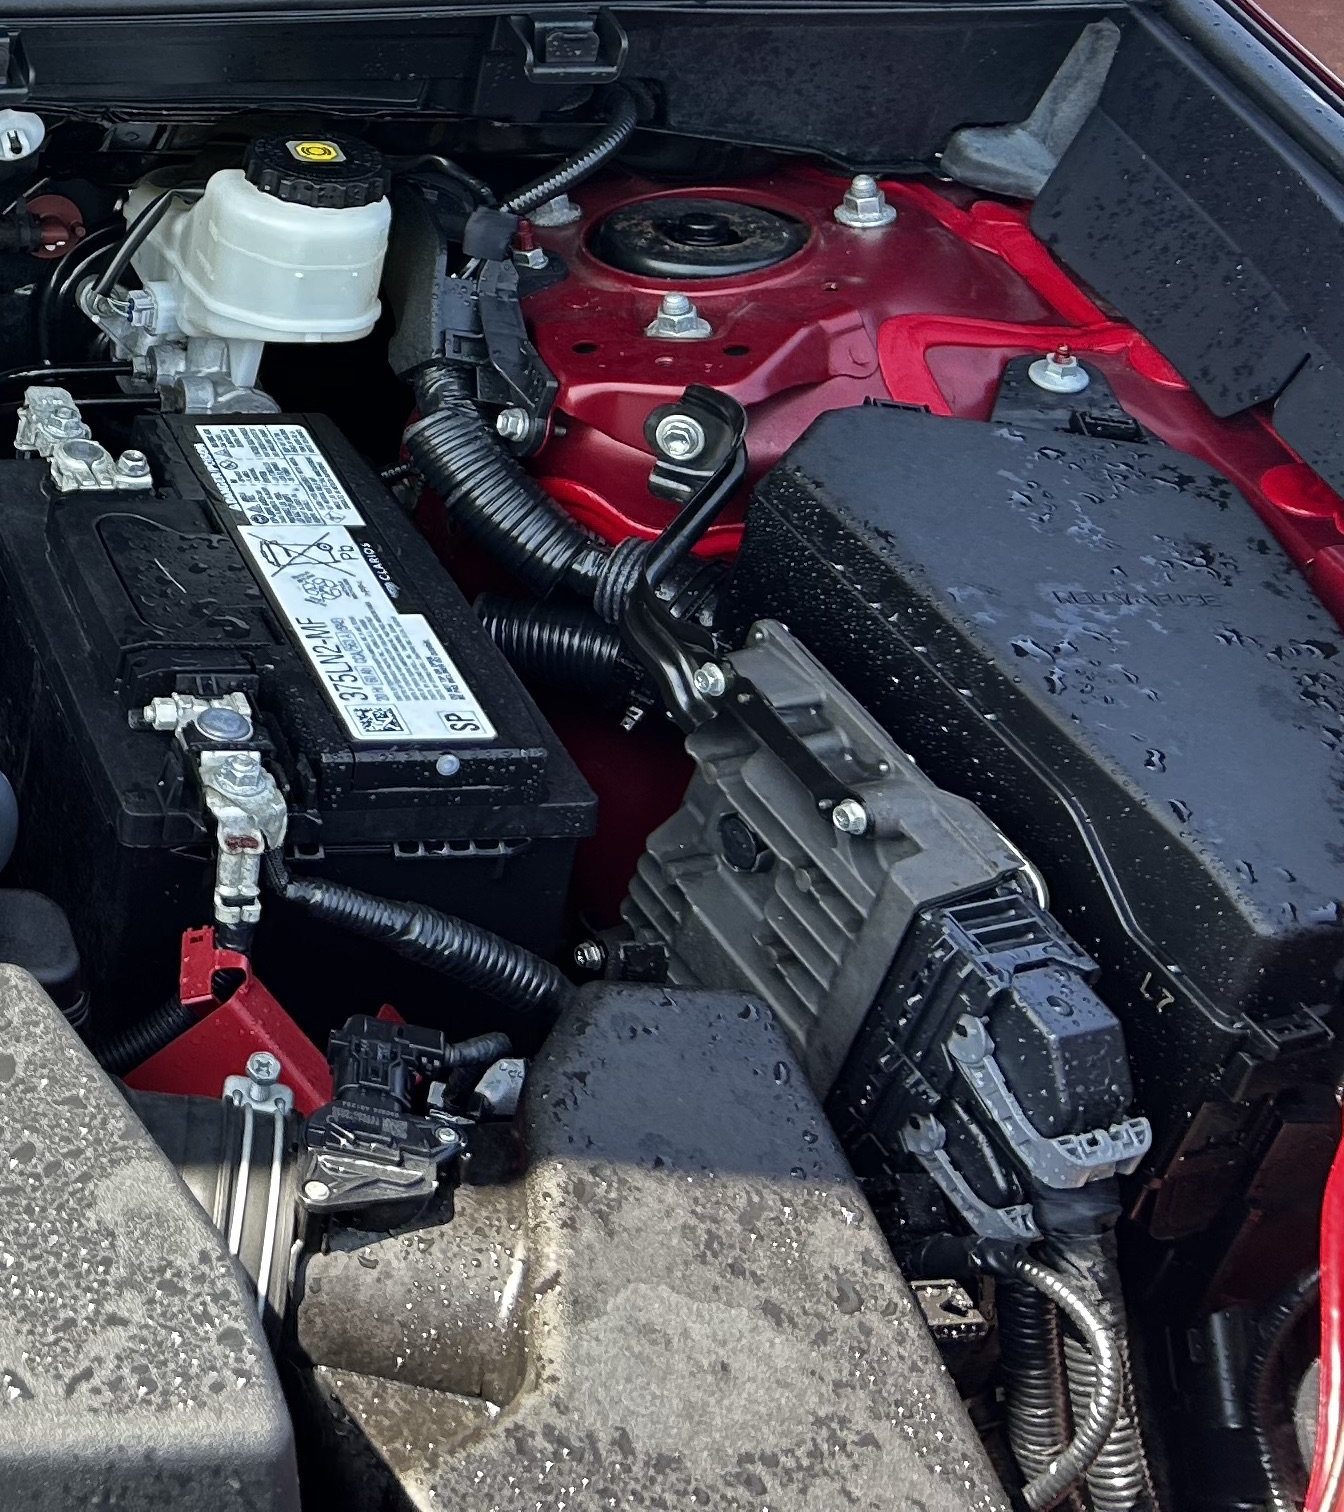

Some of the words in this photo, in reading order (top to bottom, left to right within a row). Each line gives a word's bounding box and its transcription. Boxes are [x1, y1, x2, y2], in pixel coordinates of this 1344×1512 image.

[335, 545, 359, 560] Pb
[359, 542, 391, 580] CLARIOS
[294, 617, 369, 700] 375LN2-MF
[446, 712, 480, 731] SP
[1140, 971, 1175, 1013] L7
